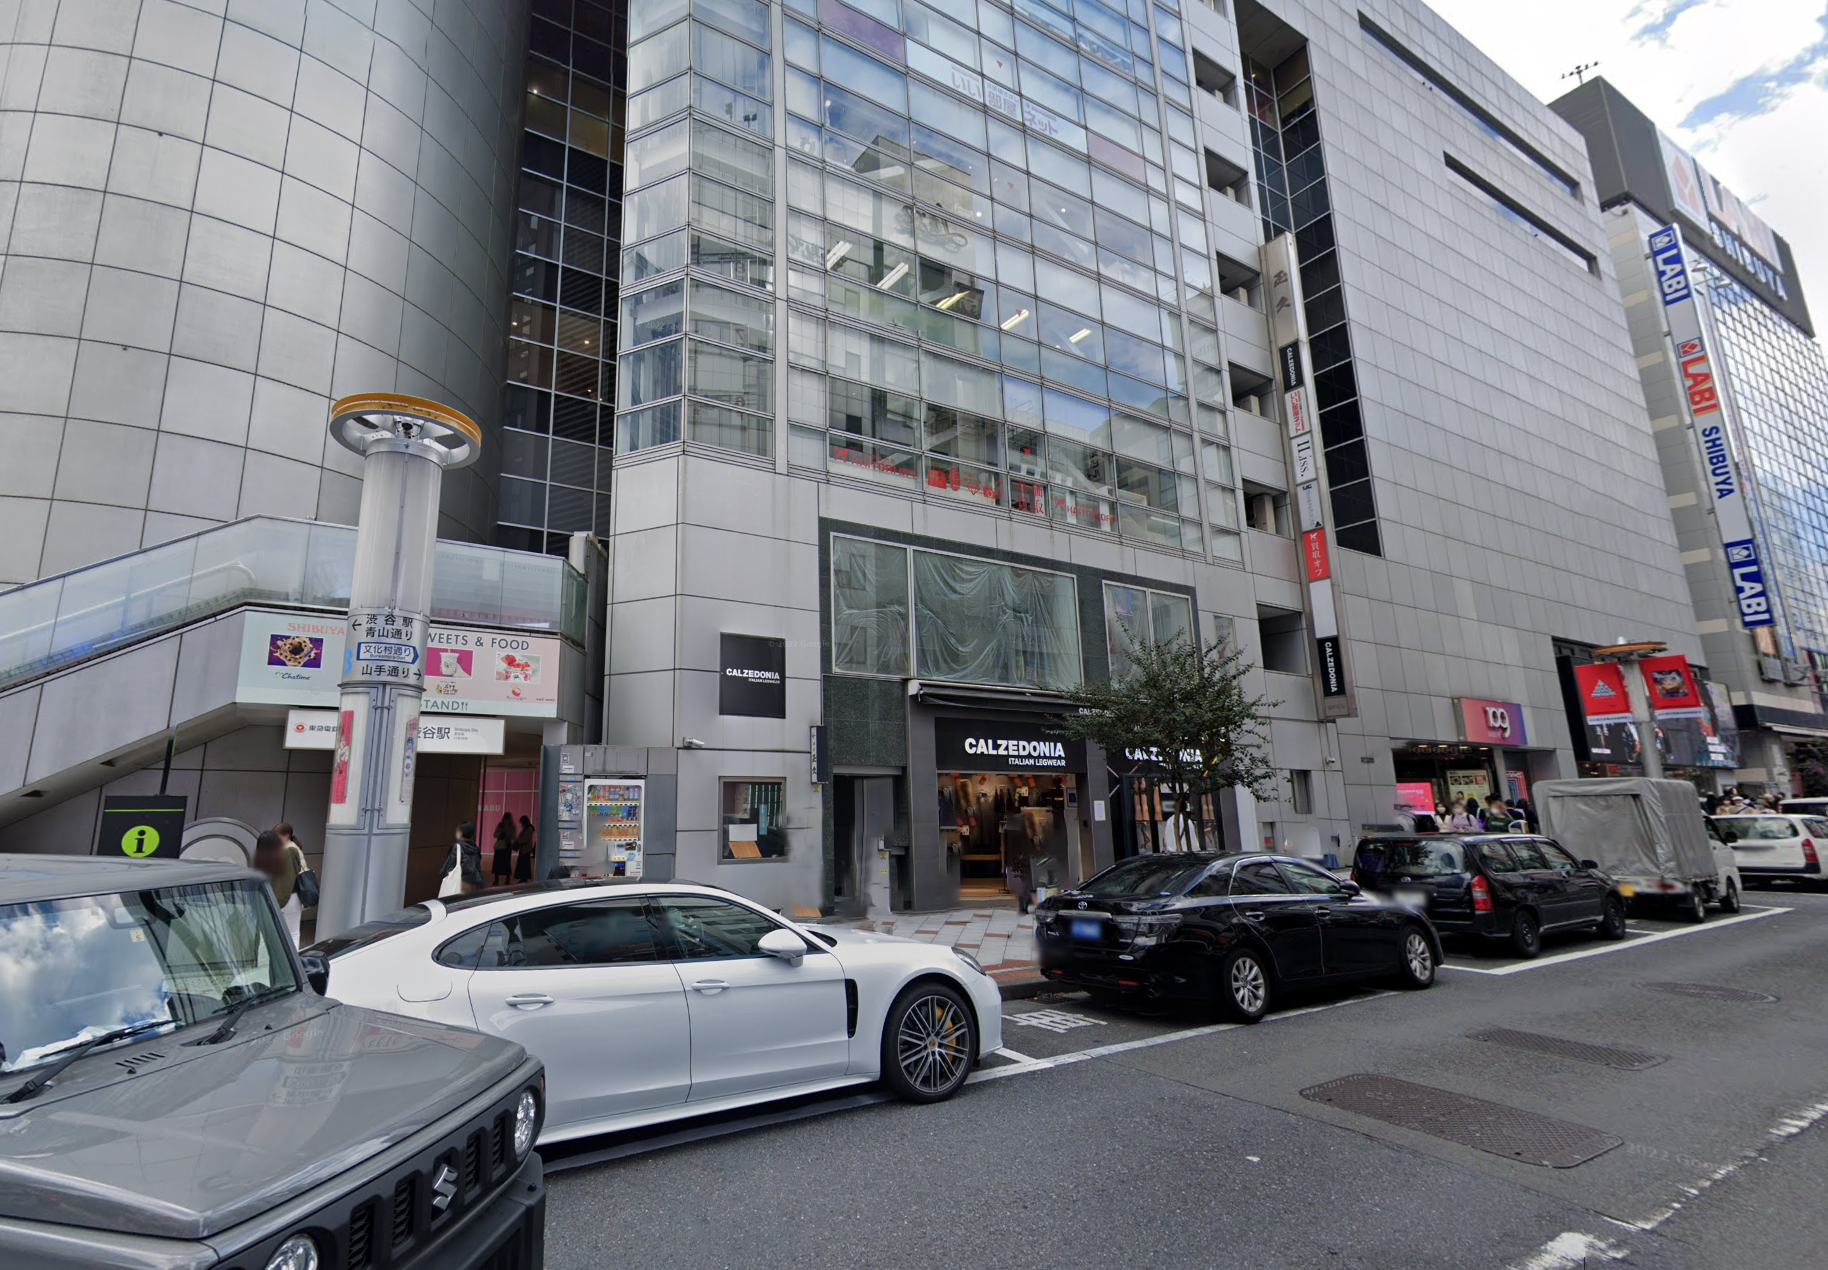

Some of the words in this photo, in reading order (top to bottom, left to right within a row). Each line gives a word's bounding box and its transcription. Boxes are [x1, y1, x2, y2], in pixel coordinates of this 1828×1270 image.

[1656, 248, 1689, 302] LABI
[1286, 346, 1297, 388] CALZEDONIA
[1681, 353, 1719, 417] LABI
[1701, 424, 1735, 500] SHIBUYA
[1733, 565, 1771, 623] LABI
[365, 613, 413, 628] 渋谷駅
[287, 622, 346, 636] SHIBUYA
[365, 627, 413, 641] 青山通り
[363, 644, 411, 657] 文化村通り
[475, 637, 484, 648] &
[491, 637, 530, 651] FOOD
[361, 664, 410, 679] 山手通り
[726, 668, 780, 680] CALZEDONIA
[1324, 641, 1338, 693] CALZEDONIA
[281, 672, 311, 681] Chatime
[1485, 706, 1511, 738] 109
[964, 737, 1066, 757] CALZEDONIA
[1008, 757, 1035, 766] ITALIAN
[1036, 758, 1066, 767] LEGWEAR
